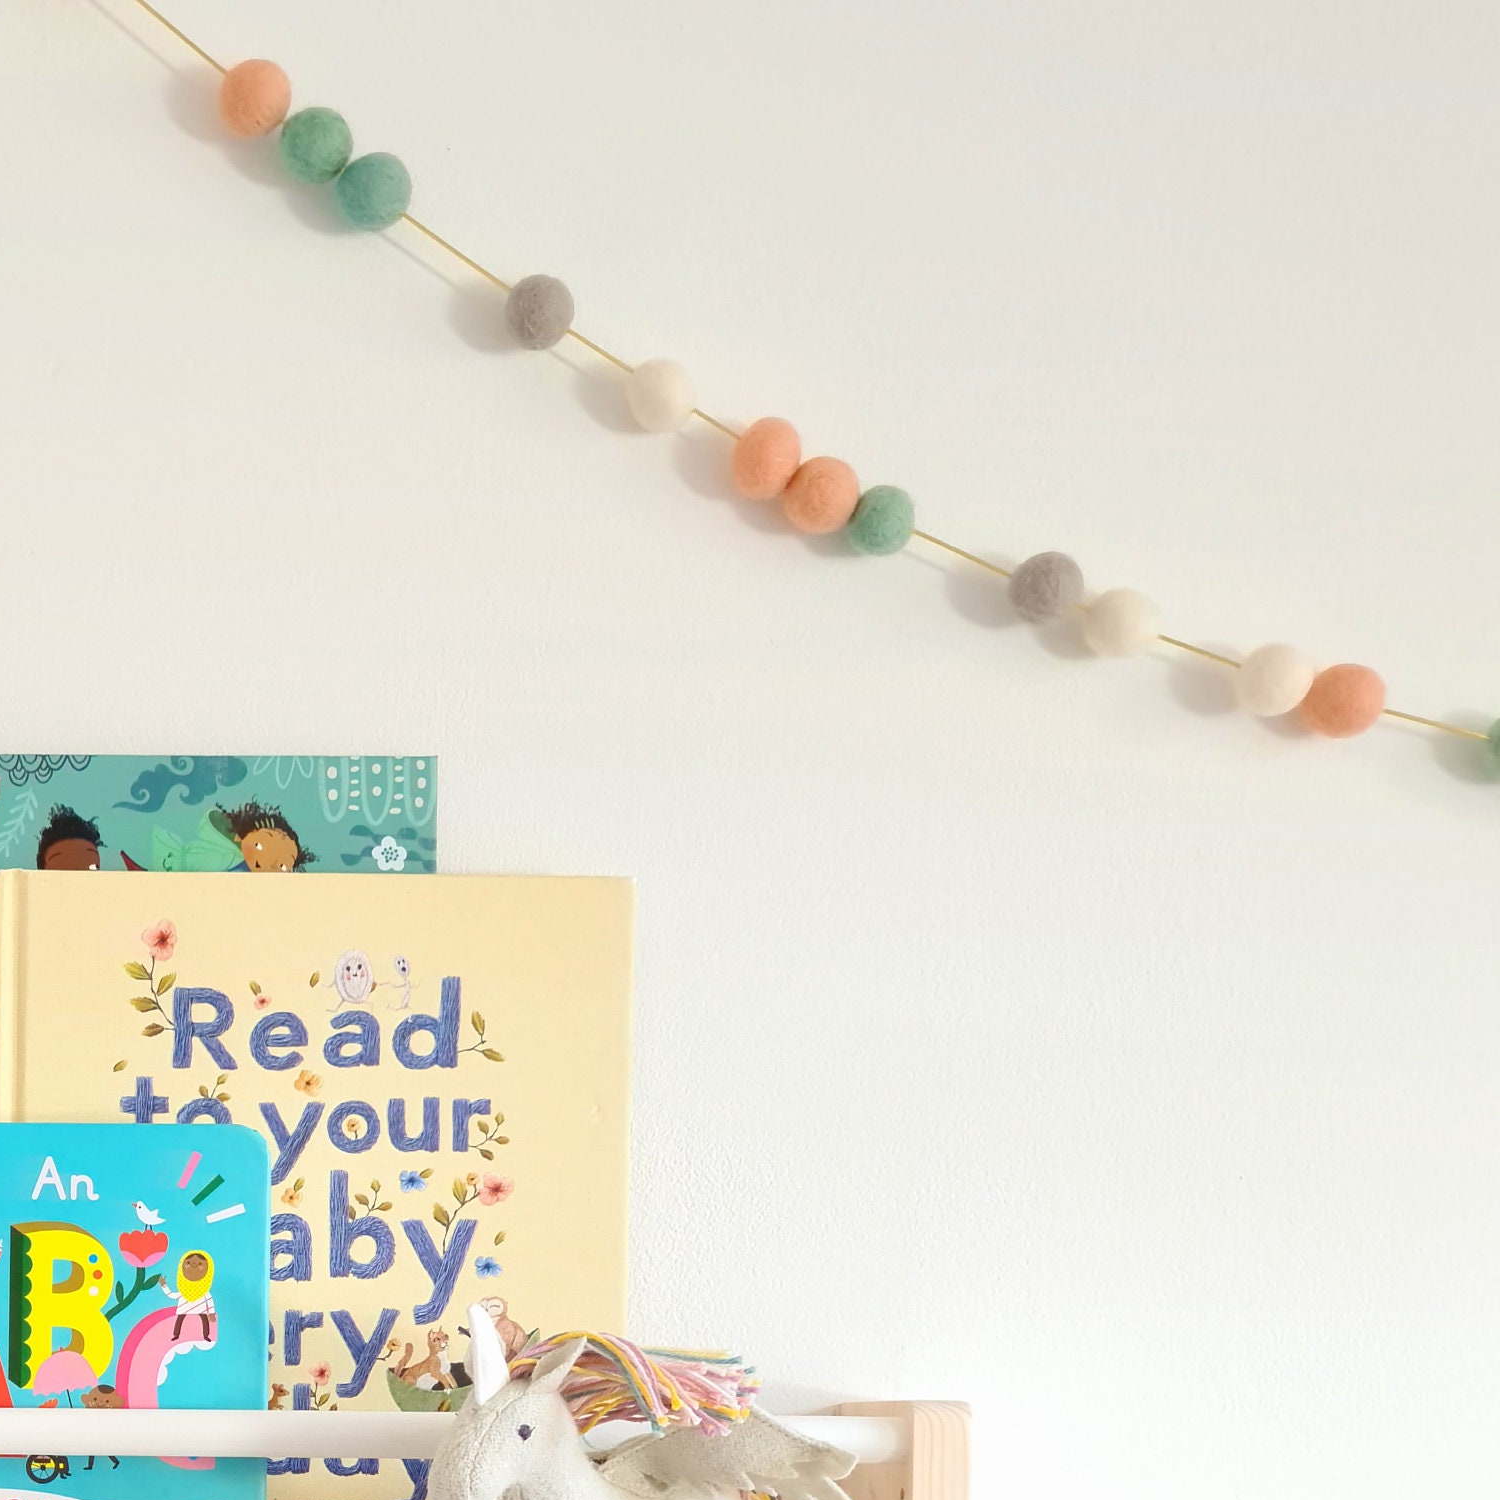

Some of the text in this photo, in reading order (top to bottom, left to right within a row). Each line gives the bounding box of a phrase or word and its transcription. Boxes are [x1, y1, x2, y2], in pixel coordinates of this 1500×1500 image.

[171, 976, 461, 1071] Read
[31, 1155, 100, 1201] An
[258, 1096, 492, 1186] your
[270, 1169, 478, 1326] aby
